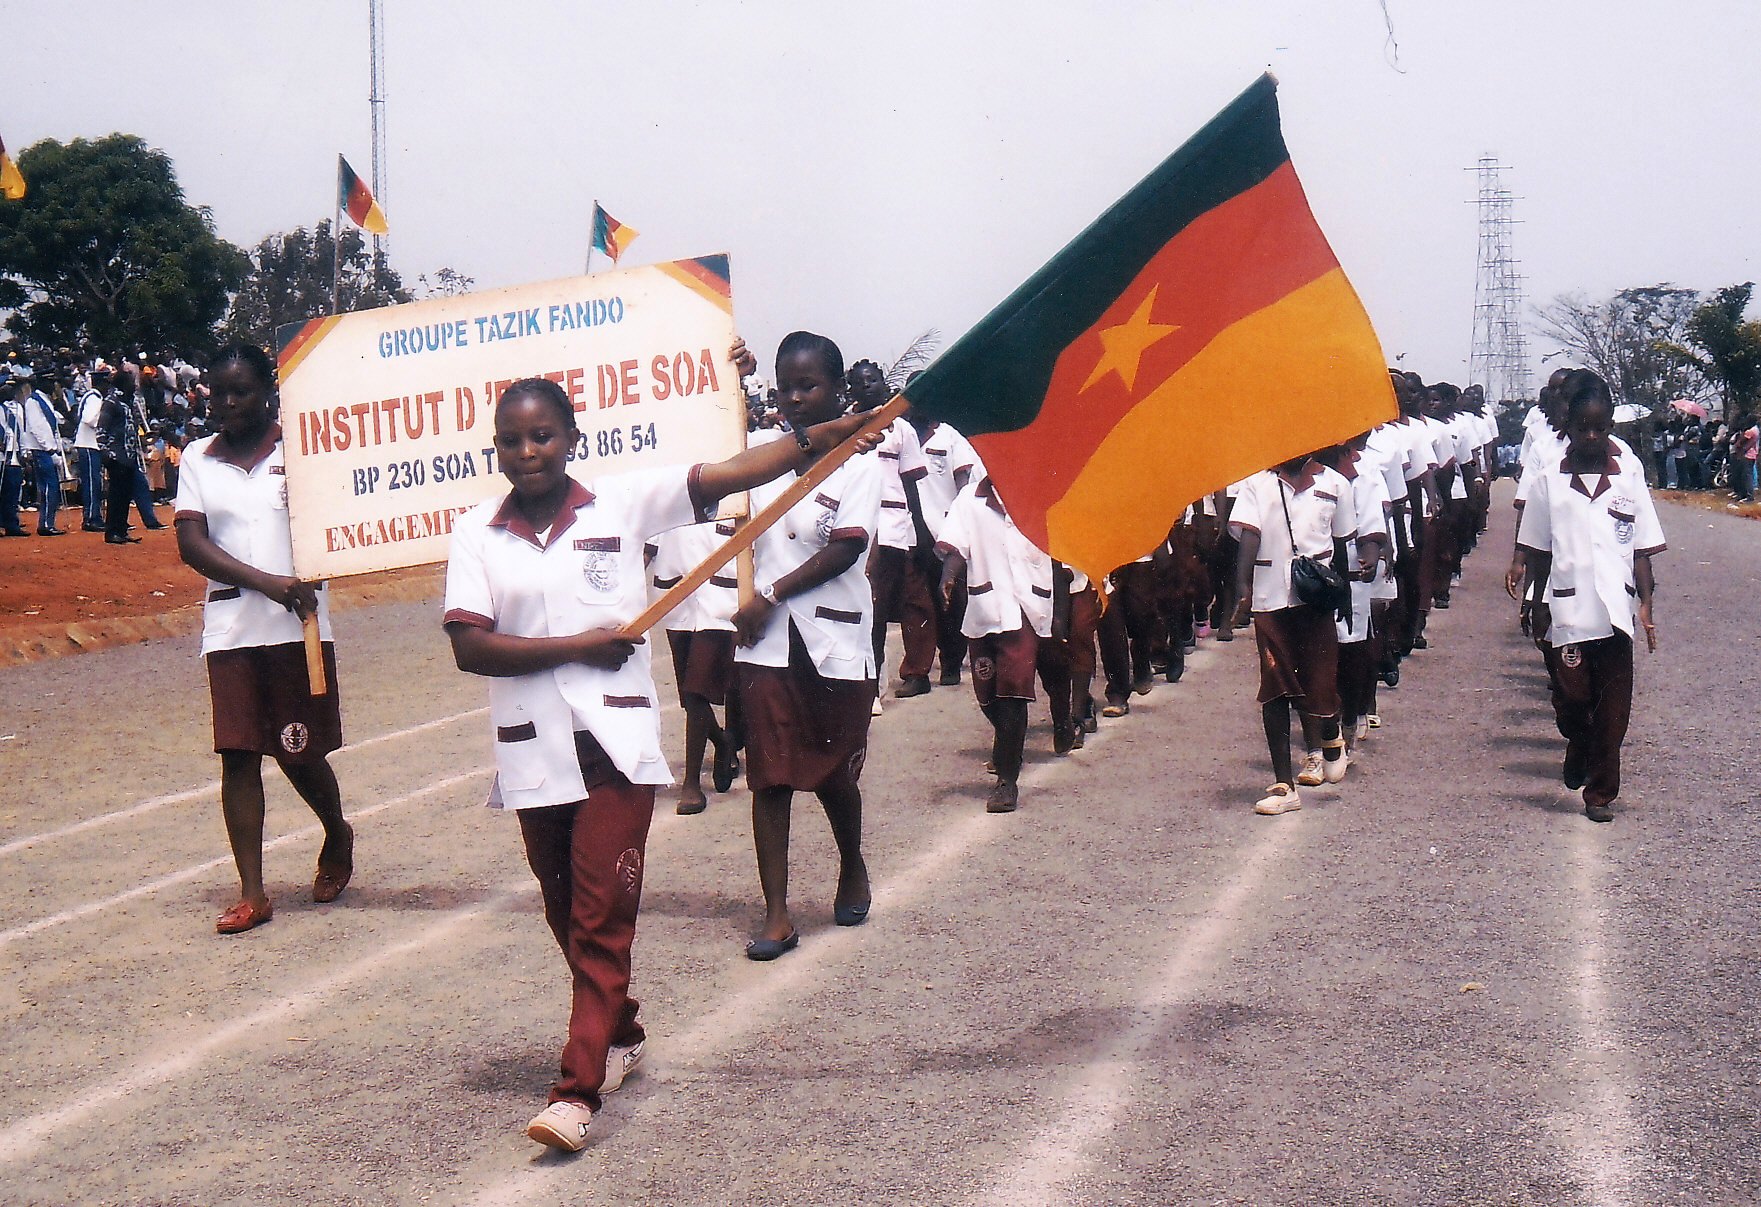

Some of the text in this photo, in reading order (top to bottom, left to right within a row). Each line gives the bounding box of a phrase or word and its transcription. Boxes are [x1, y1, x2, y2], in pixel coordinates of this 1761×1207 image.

[378, 296, 624, 358] GROUPE TAZIK FANDO
[299, 391, 444, 456] INSTITUT
[597, 360, 640, 410] DE
[652, 348, 719, 401] SOA
[353, 466, 380, 496] BP
[387, 458, 426, 491] 230
[432, 451, 477, 484] SOA
[596, 427, 624, 458] 86
[630, 422, 658, 452] 54
